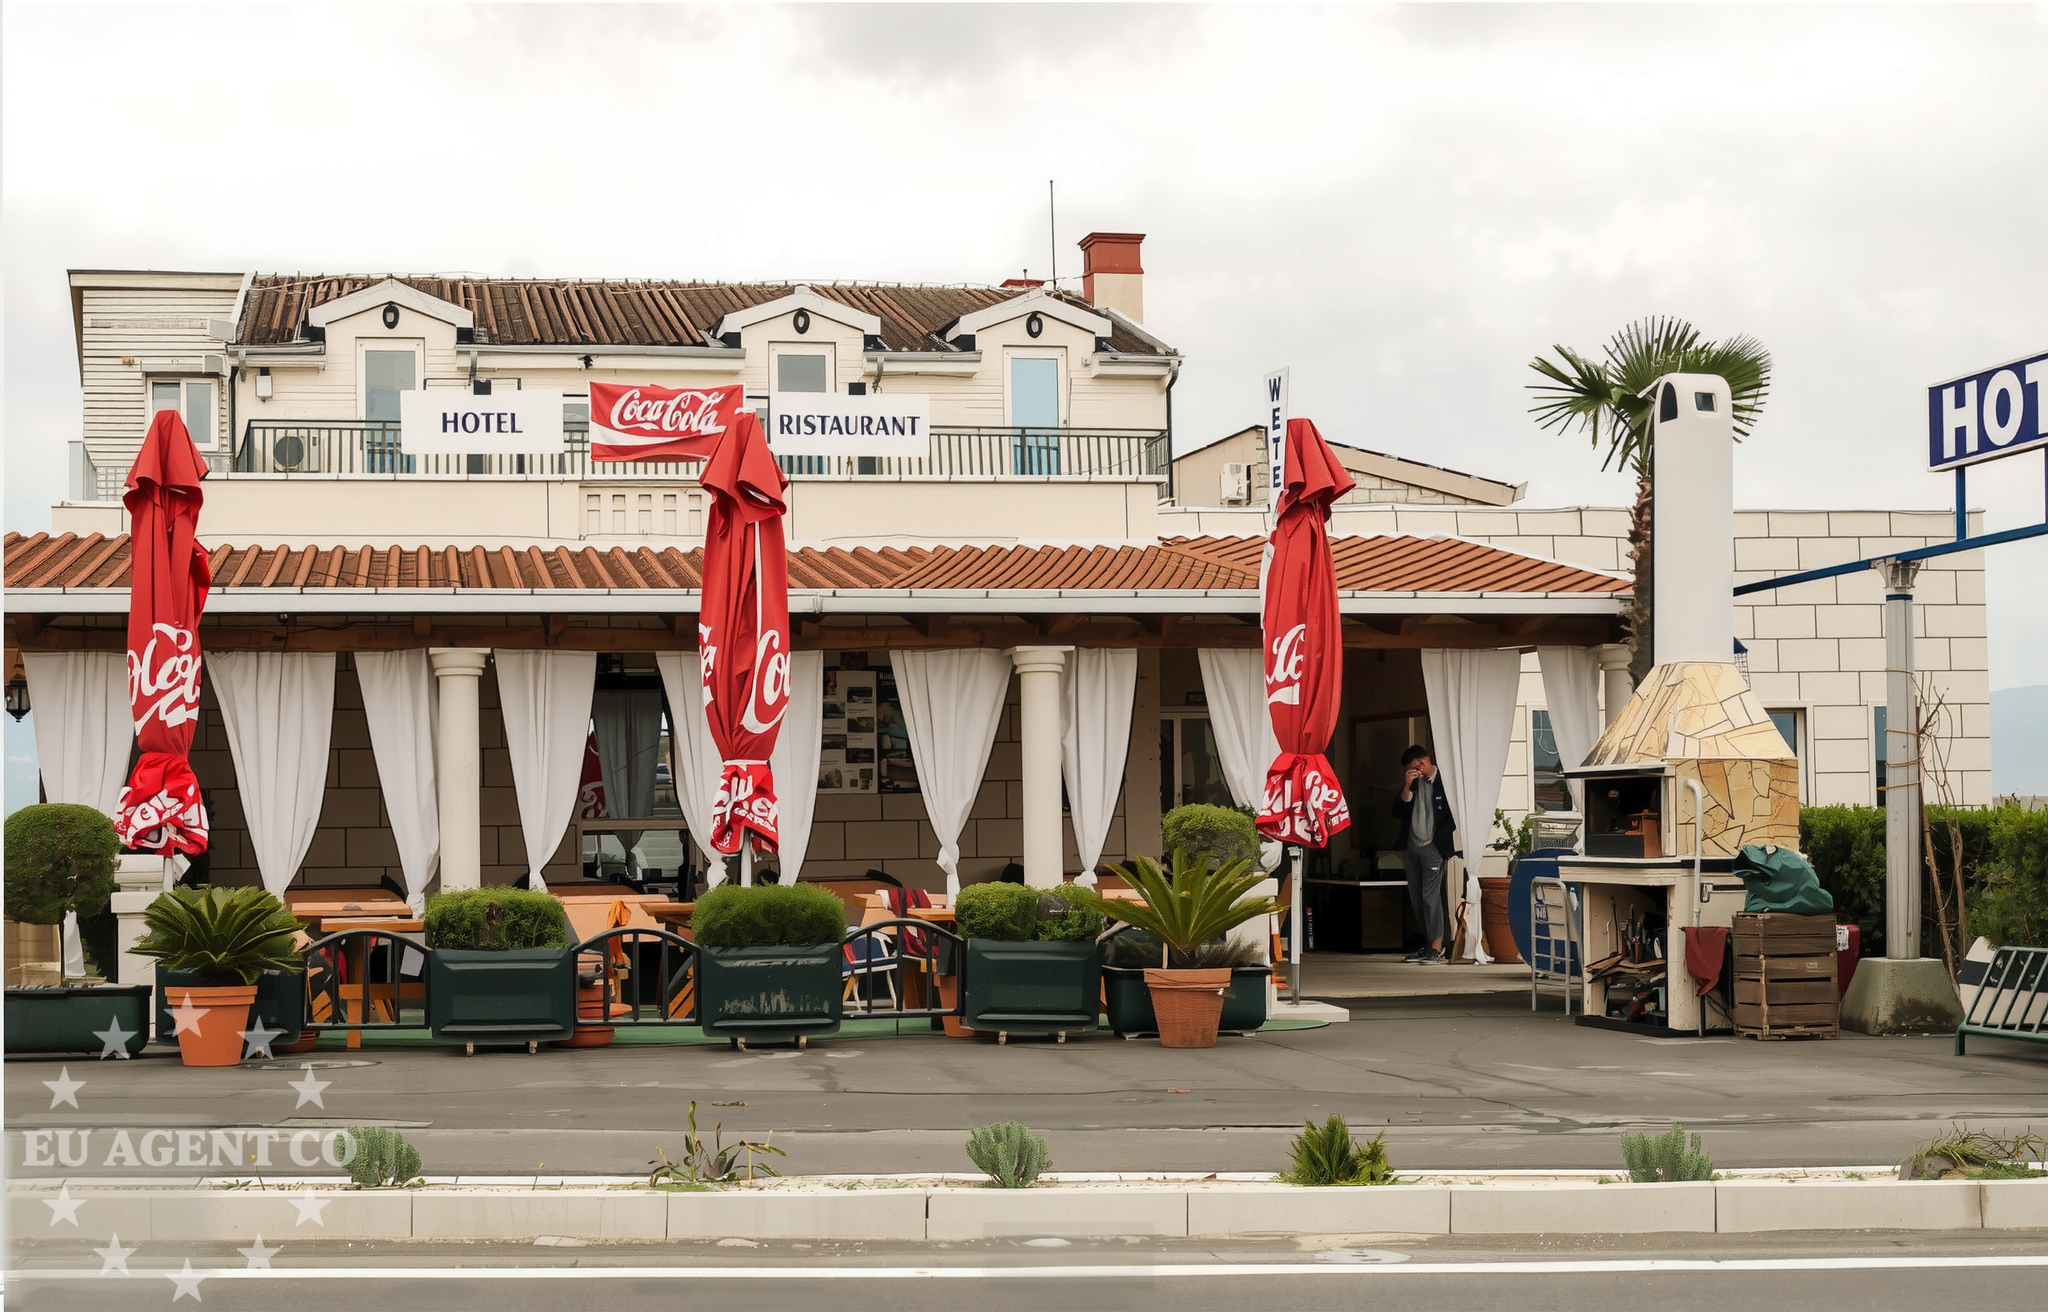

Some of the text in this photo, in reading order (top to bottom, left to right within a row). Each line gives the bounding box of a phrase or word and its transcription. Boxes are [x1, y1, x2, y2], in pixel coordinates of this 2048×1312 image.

[1942, 358, 2048, 460] HOT
[442, 411, 524, 434] HOTEL
[779, 413, 921, 437] RISTAURANT
